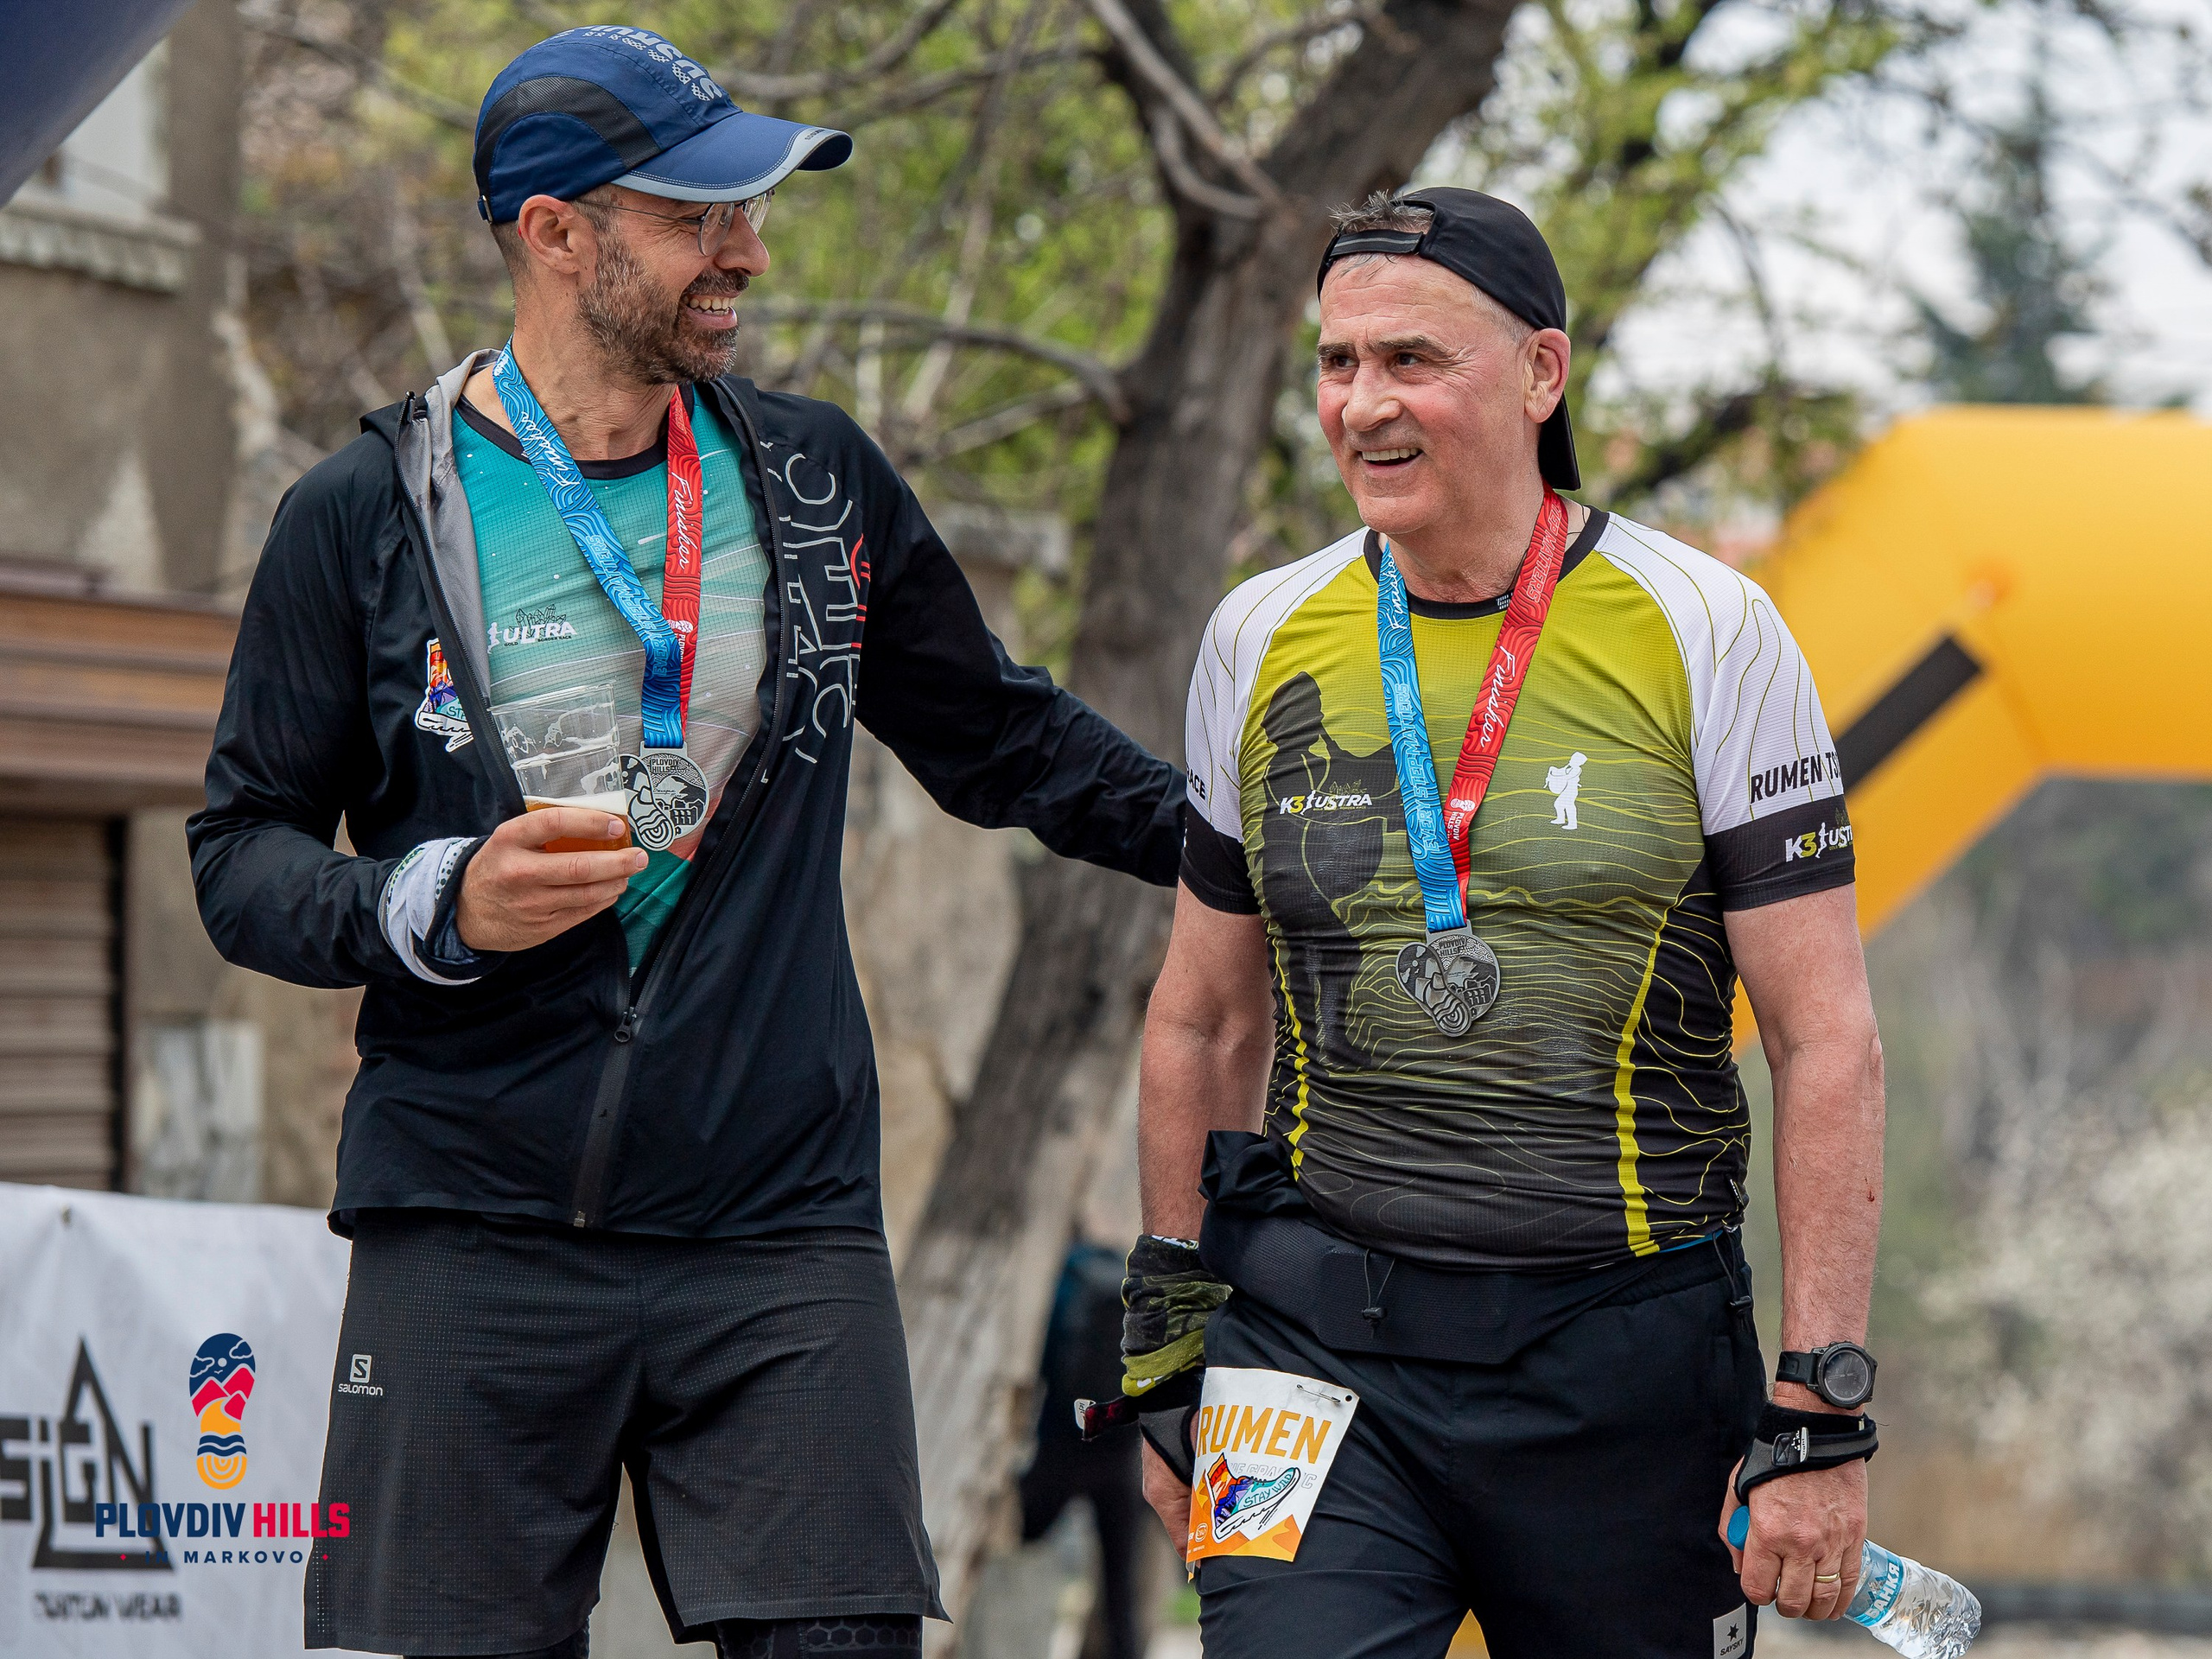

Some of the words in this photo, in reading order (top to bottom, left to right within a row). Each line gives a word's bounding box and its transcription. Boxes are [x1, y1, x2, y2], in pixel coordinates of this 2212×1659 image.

[521, 410, 581, 486] Finisher
[671, 472, 698, 570] Finisher
[1382, 552, 1408, 630] Finisher
[1526, 529, 1557, 602] MATTERS
[645, 631, 669, 677] EVERY
[1395, 683, 1419, 758] MATTERS
[1478, 645, 1516, 748] Finisher
[1186, 764, 1206, 800] ACE
[1280, 795, 1306, 815] K3
[1314, 793, 1373, 810] USTRA
[1406, 759, 1429, 798] STEP
[1750, 754, 1822, 804] RUMEN
[1825, 751, 1841, 779] TS
[1414, 799, 1440, 852] EVERY
[1447, 811, 1459, 830] HILLS
[1452, 811, 1465, 841] PLOVDIV
[1785, 831, 1817, 862] K3
[1828, 824, 1853, 848] UST
[1197, 1404, 1332, 1465] RUMEN
[1243, 1488, 1272, 1508] STAY
[1272, 1473, 1294, 1494] WILD
[1864, 1561, 1901, 1619] БАНКЯ
